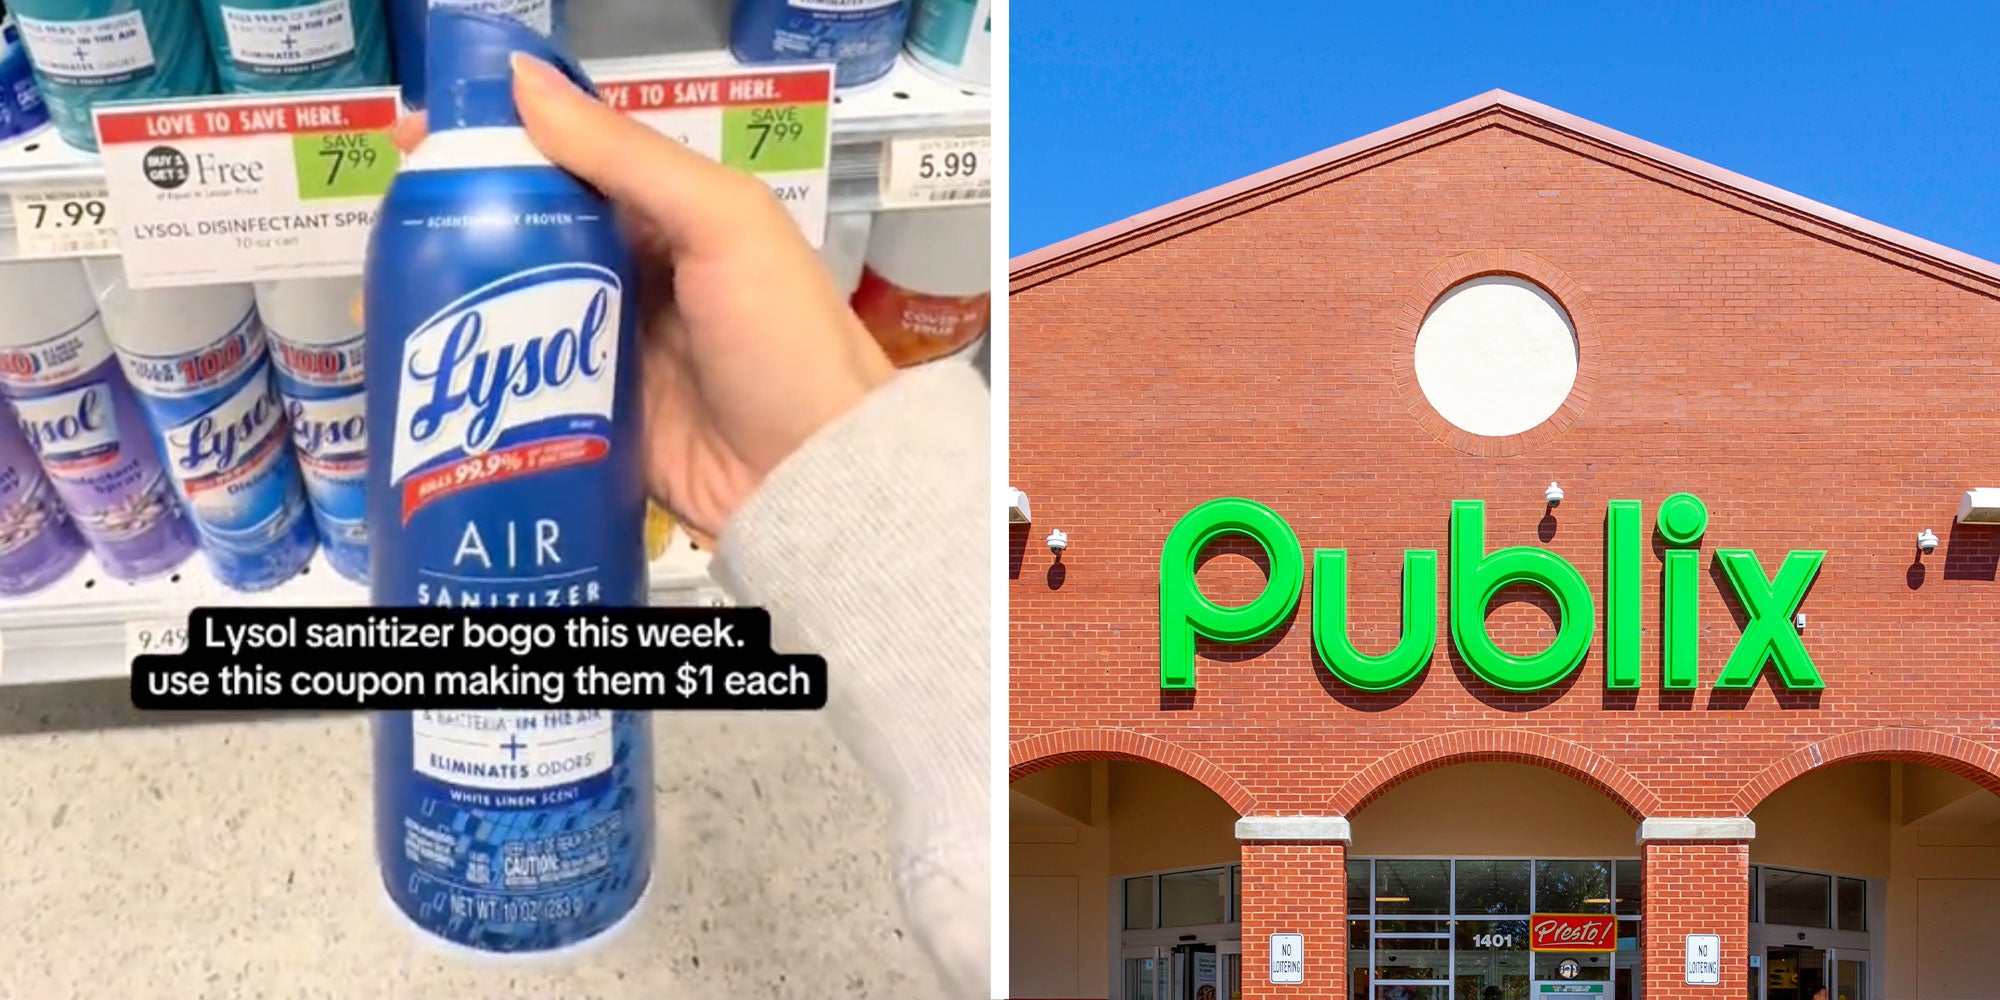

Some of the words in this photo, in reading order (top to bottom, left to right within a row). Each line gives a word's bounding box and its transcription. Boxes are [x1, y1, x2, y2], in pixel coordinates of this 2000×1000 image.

[305, 20, 323, 30] THE
[327, 13, 343, 23] AIR
[95, 33, 114, 43] THE
[118, 29, 137, 39] AIR
[600, 86, 629, 108] VE
[640, 85, 665, 106] TO
[674, 82, 720, 104] SAVE
[730, 79, 781, 101] HERE.
[146, 113, 196, 136] LOVE
[205, 111, 230, 132] TO
[239, 108, 287, 131] SAVE
[296, 105, 349, 127] HERE.
[751, 107, 798, 123] SAVE
[322, 134, 369, 149] SAVE
[147, 155, 172, 168] BUY
[195, 152, 264, 185] Free
[920, 151, 978, 178] 5.99
[150, 168, 175, 181] GET
[27, 200, 107, 229] 7.99
[134, 220, 193, 239] LYSOL
[197, 213, 332, 236] DISINFECTANT
[525, 213, 573, 225] PROVEN
[408, 287, 607, 447] Lysol
[455, 452, 522, 484] 99.9%
[453, 520, 562, 569] AIR
[417, 581, 600, 608] SANITIZER
[1159, 492, 1828, 692] Publix
[516, 717, 536, 730] IN
[543, 713, 573, 728] THE
[430, 752, 530, 779] ELIMINATES
[536, 753, 593, 777] ODORS
[450, 788, 490, 806] WHITE
[495, 793, 537, 807] LINEN
[542, 787, 579, 804] SCENT
[451, 893, 473, 916] NET
[504, 899, 519, 922] 10
[1472, 934, 1512, 947] 1401
[1534, 919, 1614, 946] Presto!
[1281, 943, 1292, 957] NO
[1698, 944, 1708, 957] NO
[1273, 960, 1301, 974] LOITERING
[1689, 960, 1717, 974] LOITERING
